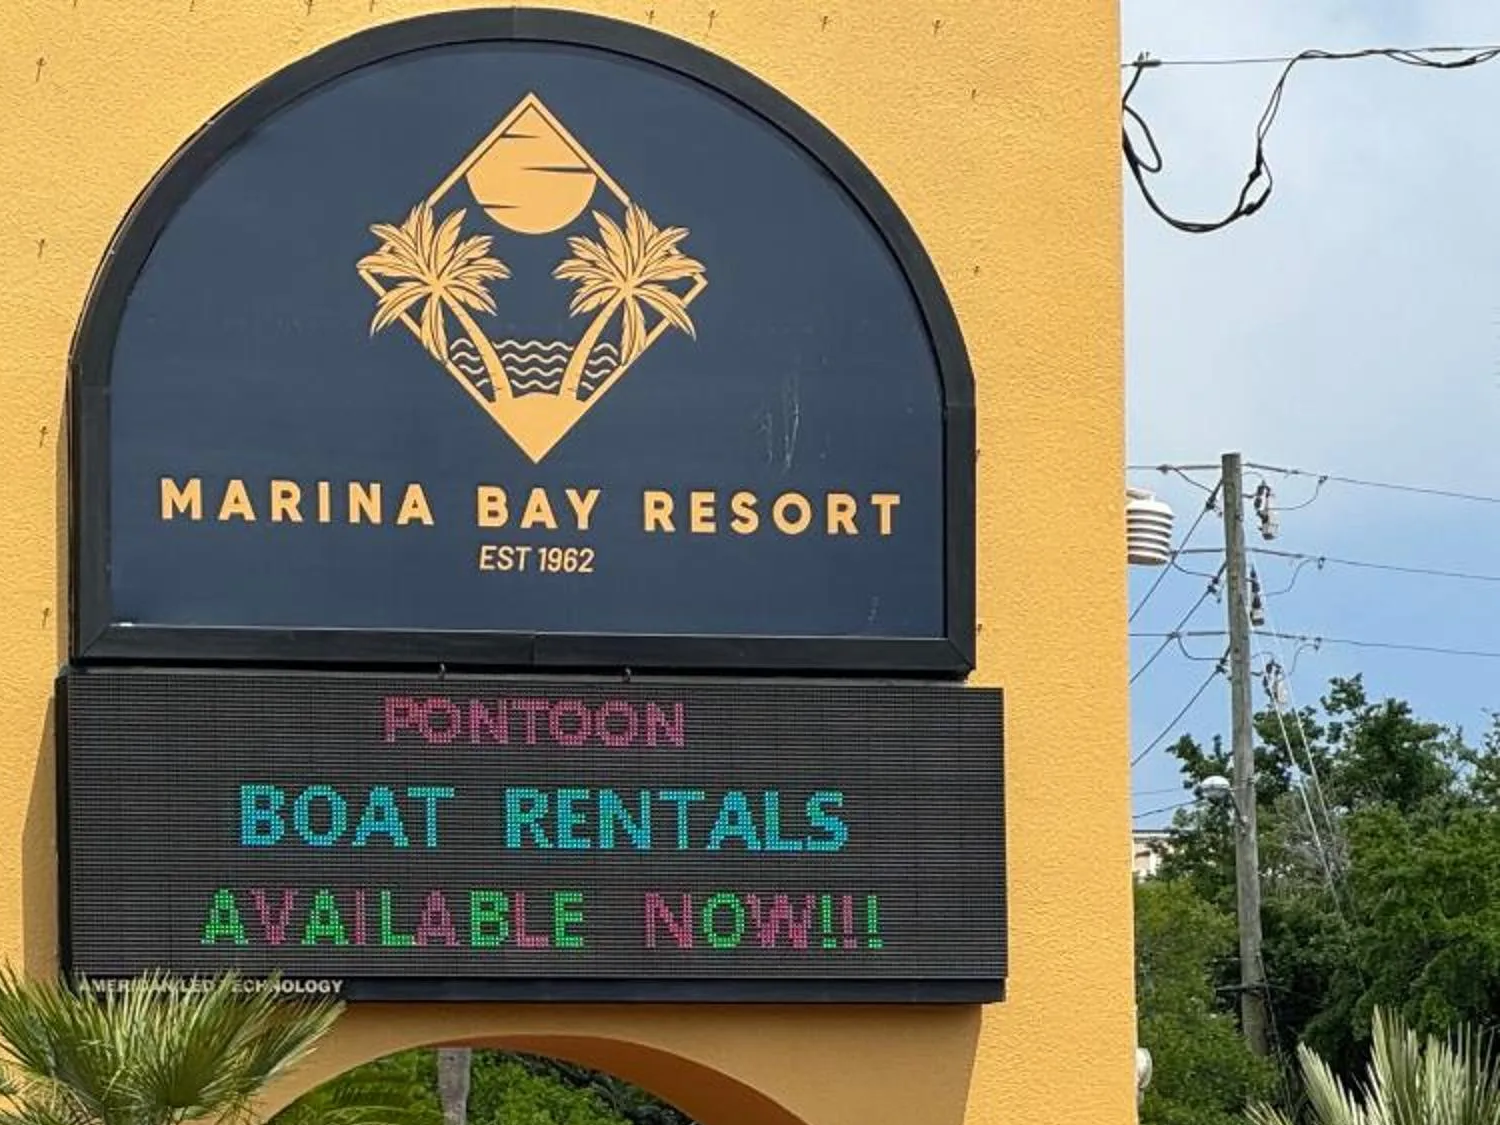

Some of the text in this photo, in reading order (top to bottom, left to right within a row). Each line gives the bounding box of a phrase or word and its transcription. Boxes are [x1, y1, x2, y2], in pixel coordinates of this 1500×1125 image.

[161, 477, 901, 535] MARINA BAY RESORT
[478, 545, 595, 573] EST 1962
[382, 695, 686, 748] PONTOON
[239, 784, 850, 852] BOAT RENTALS
[200, 888, 885, 949] AVAILABLE NOW!!!
[220, 978, 343, 994] ECHOLOGY
